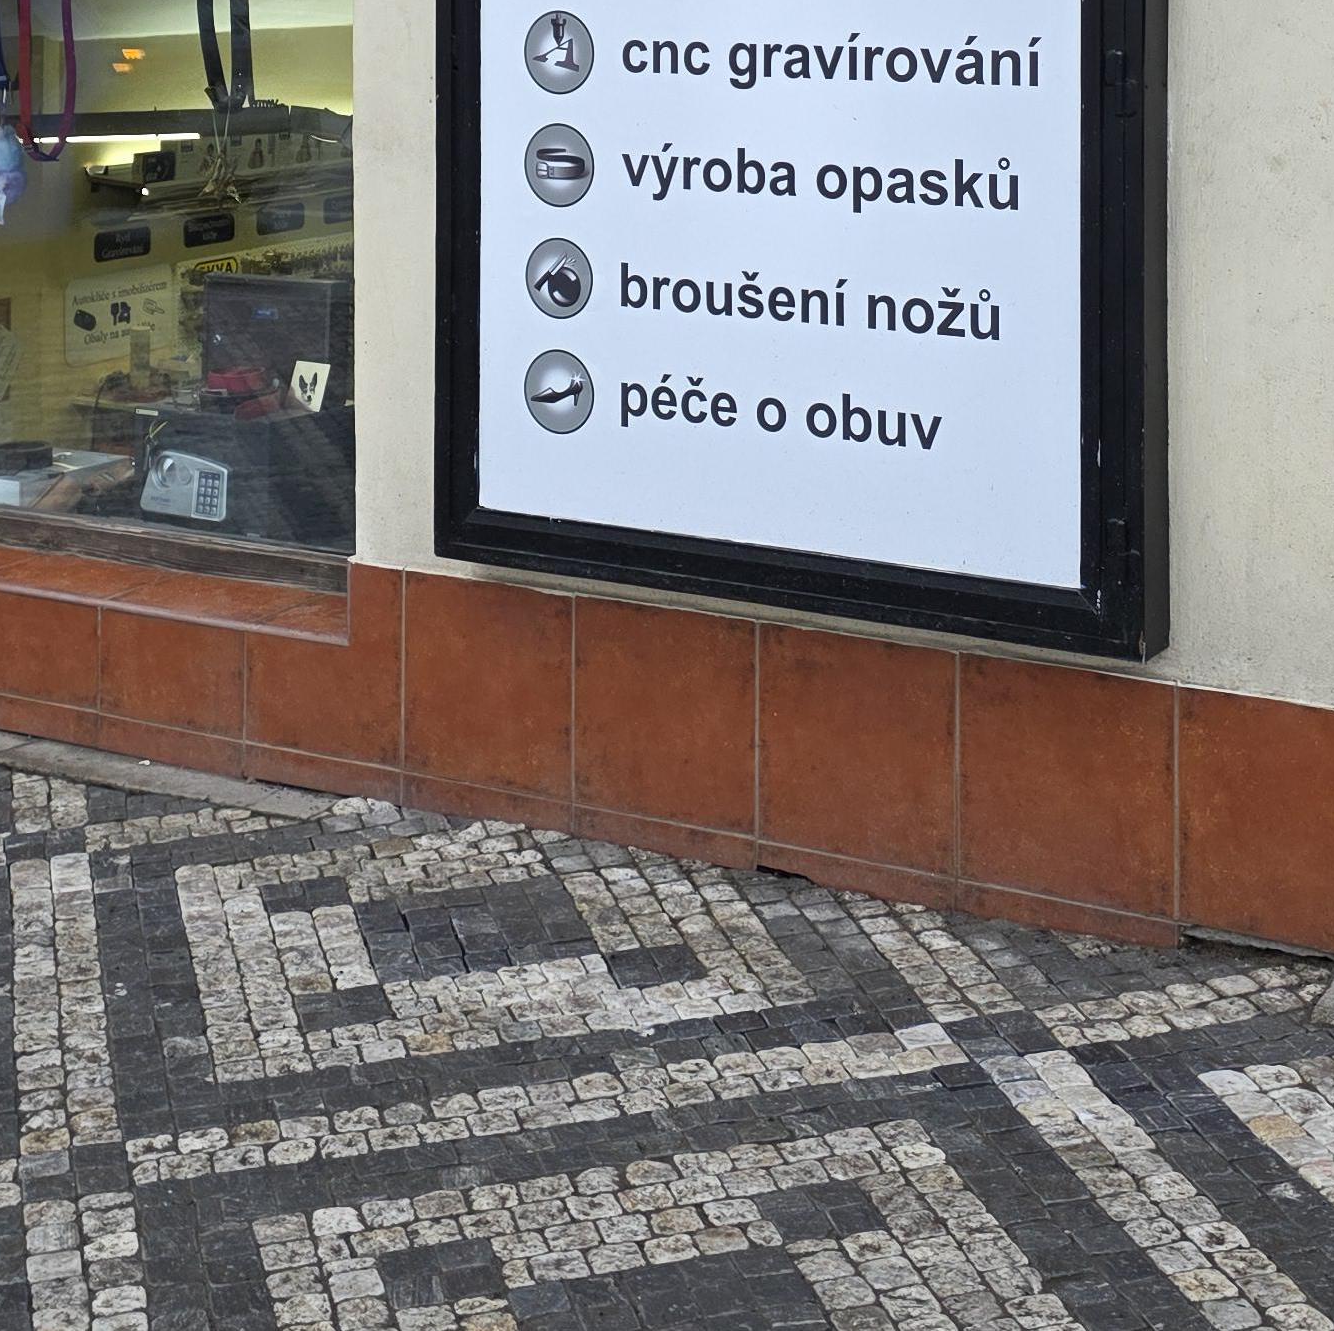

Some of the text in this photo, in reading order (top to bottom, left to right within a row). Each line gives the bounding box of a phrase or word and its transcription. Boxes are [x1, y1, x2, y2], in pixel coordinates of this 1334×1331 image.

[623, 33, 1041, 89] cnc gravírování
[622, 143, 1018, 213] výroba opasků
[621, 263, 999, 340] broušení nožů
[621, 374, 942, 449] péče o obuv
